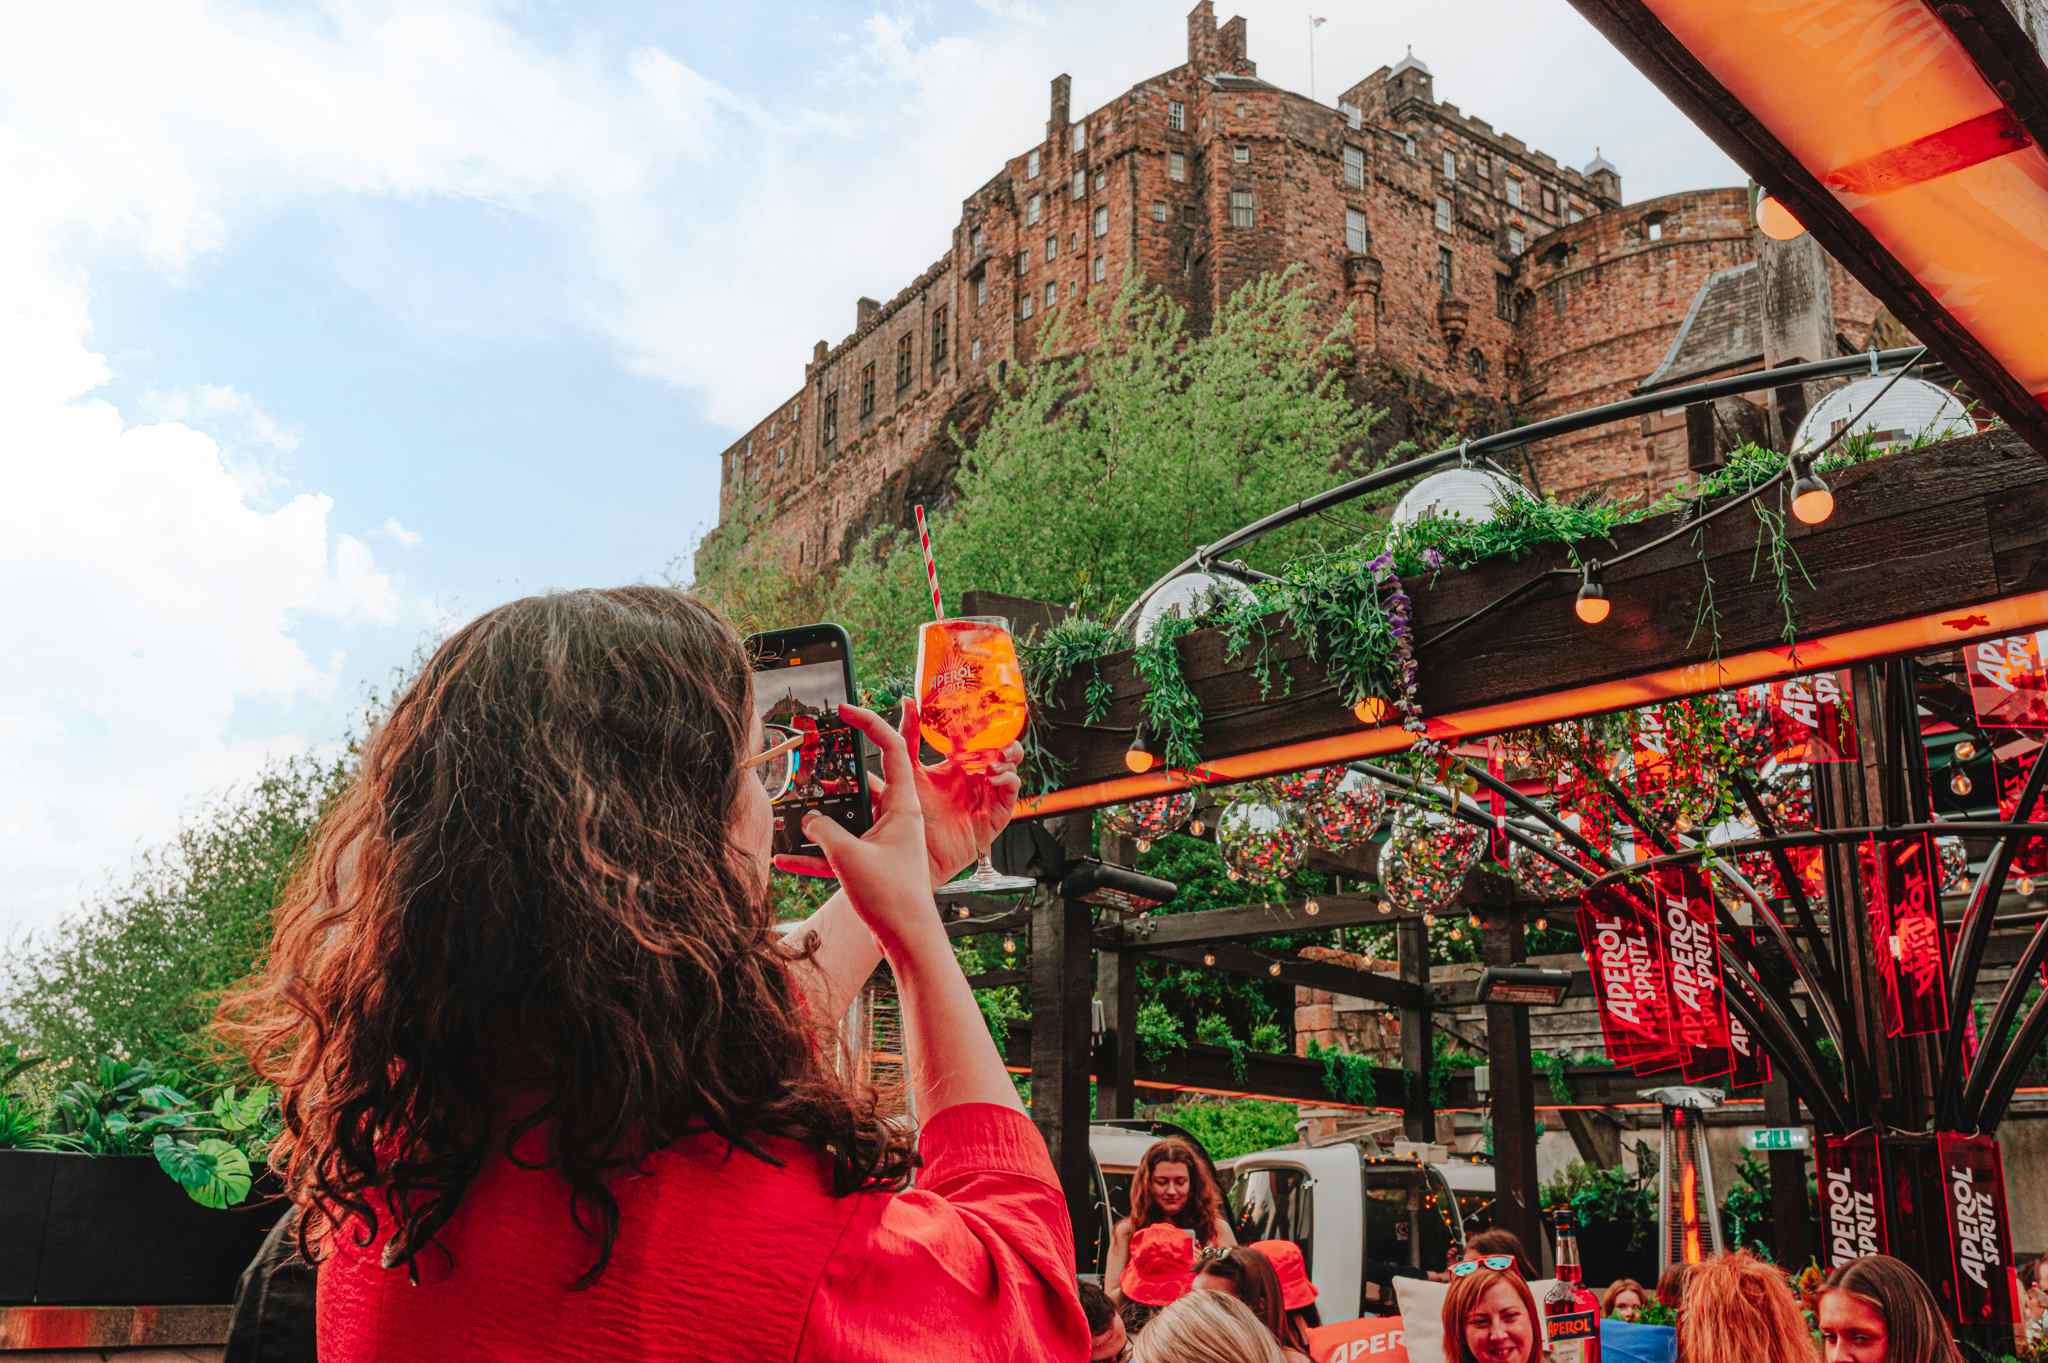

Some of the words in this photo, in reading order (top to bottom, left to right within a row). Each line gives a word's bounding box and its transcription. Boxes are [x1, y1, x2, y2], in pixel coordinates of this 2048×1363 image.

[1596, 917, 1640, 1024] APEROL
[1627, 936, 1656, 1001] SPRITZ
[1666, 896, 1701, 1012] APEROL
[1691, 920, 1715, 991] SPRITZ
[1951, 1165, 1988, 1289] APEROL
[1976, 1192, 2000, 1266] SPRITZ
[1547, 1318, 1591, 1338] APEROL
